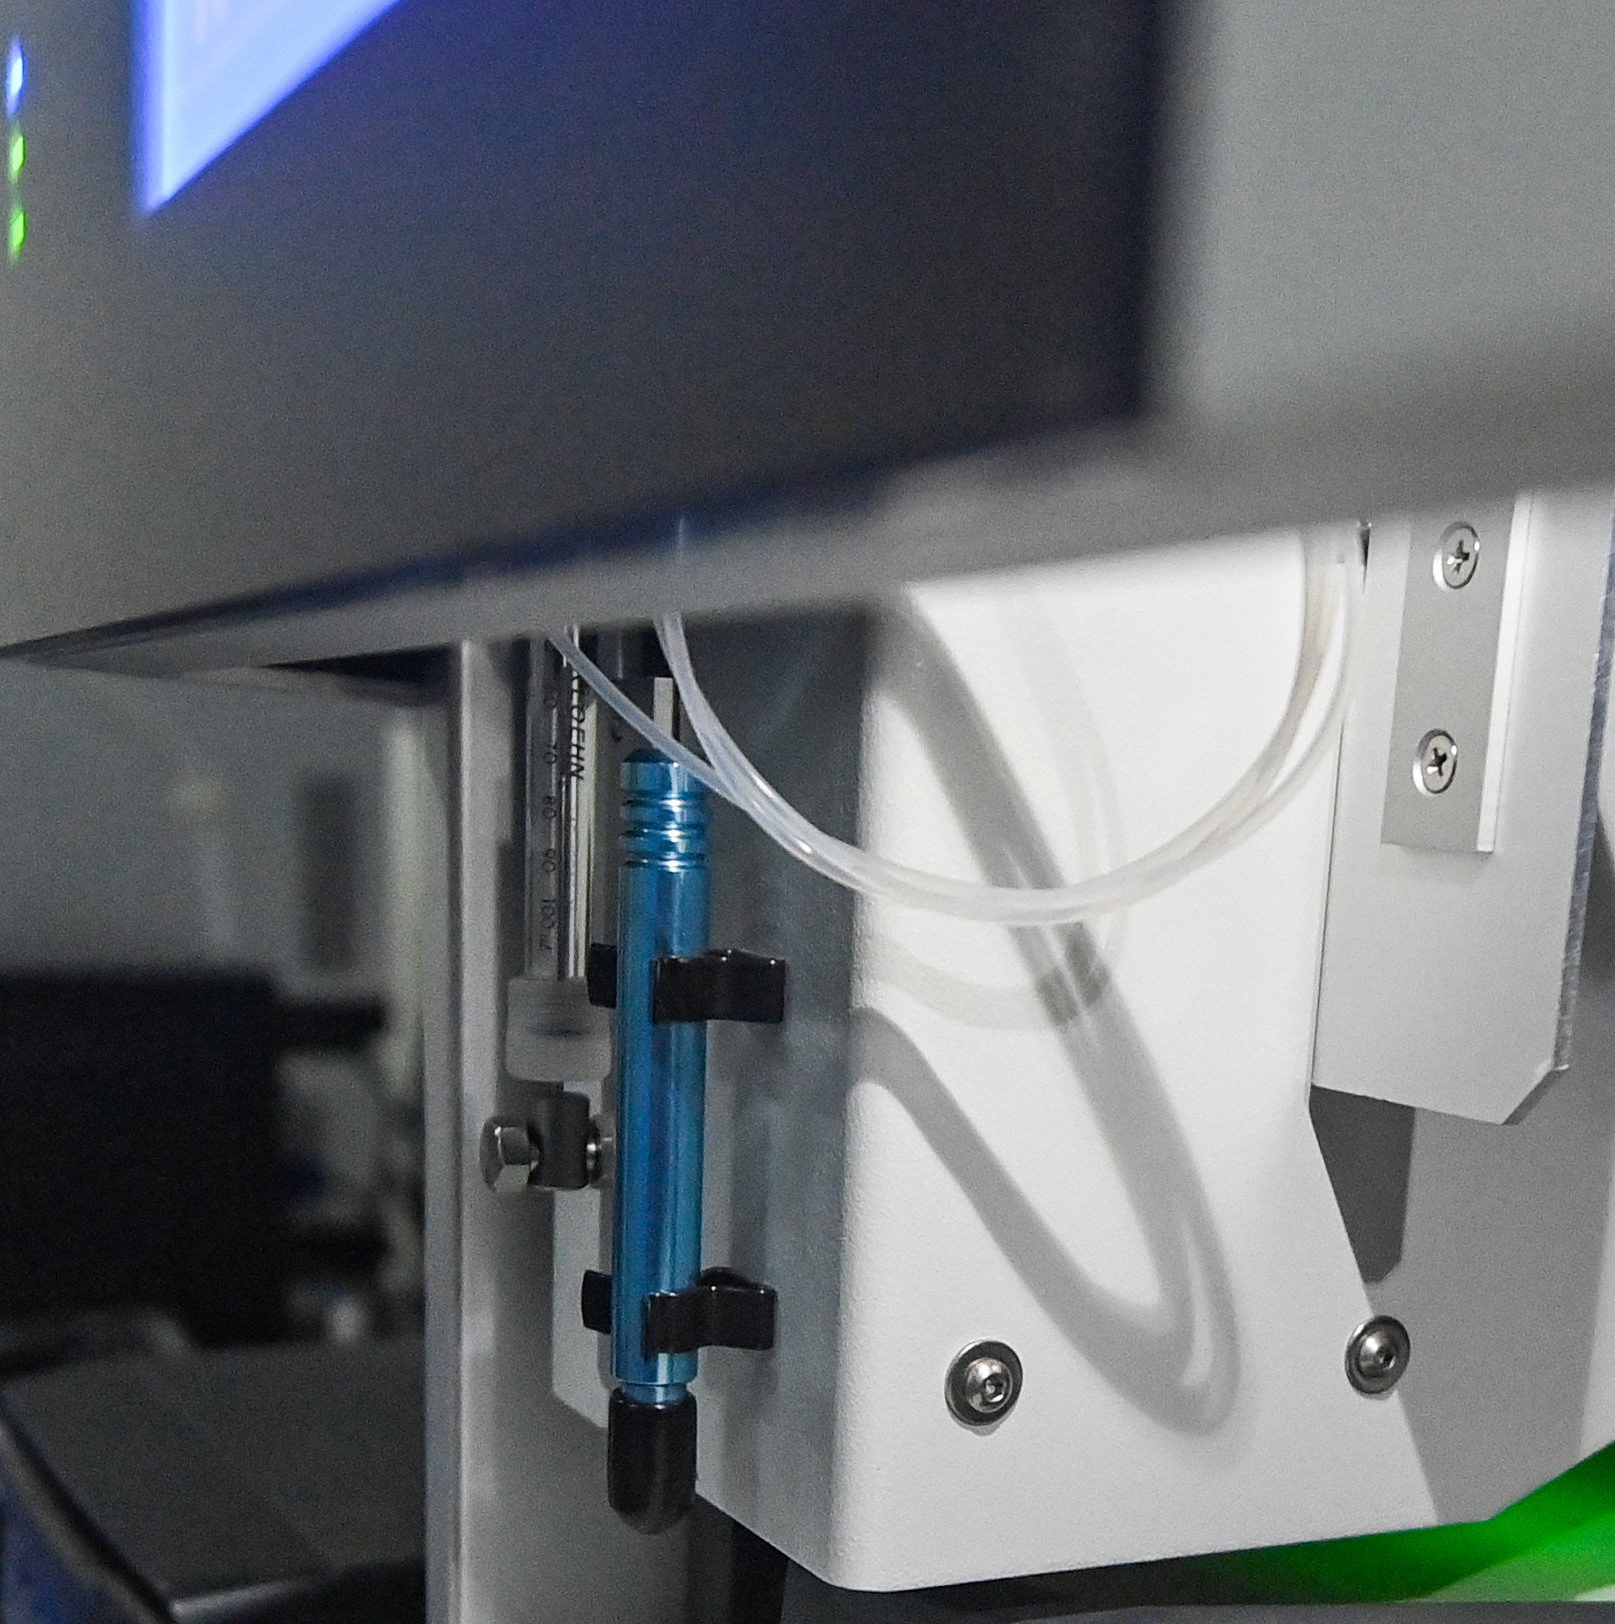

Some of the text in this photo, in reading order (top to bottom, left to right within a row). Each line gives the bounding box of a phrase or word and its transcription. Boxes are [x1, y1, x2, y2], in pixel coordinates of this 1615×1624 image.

[569, 673, 586, 782] LOEHN
[544, 741, 558, 765] 70
[542, 795, 557, 819] 80
[542, 848, 556, 872] 90
[541, 898, 556, 929] 100
